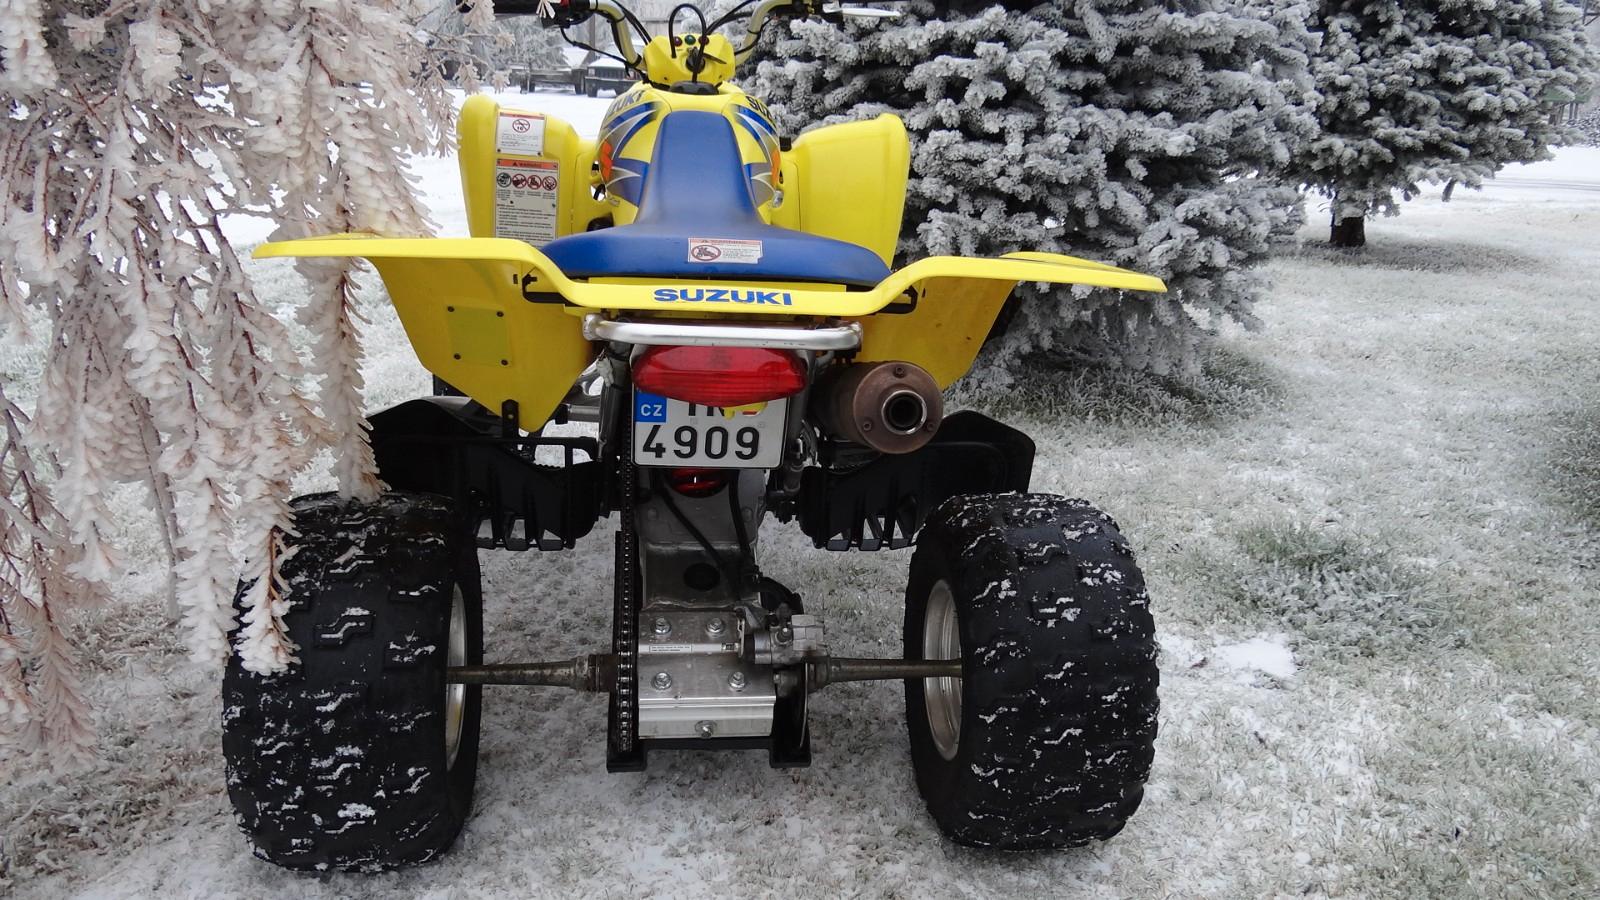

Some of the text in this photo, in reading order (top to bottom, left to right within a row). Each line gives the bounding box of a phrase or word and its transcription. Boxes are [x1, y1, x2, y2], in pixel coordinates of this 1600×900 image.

[654, 289, 792, 305] SUZUKI
[640, 403, 663, 417] CZ
[642, 424, 760, 460] 4909
